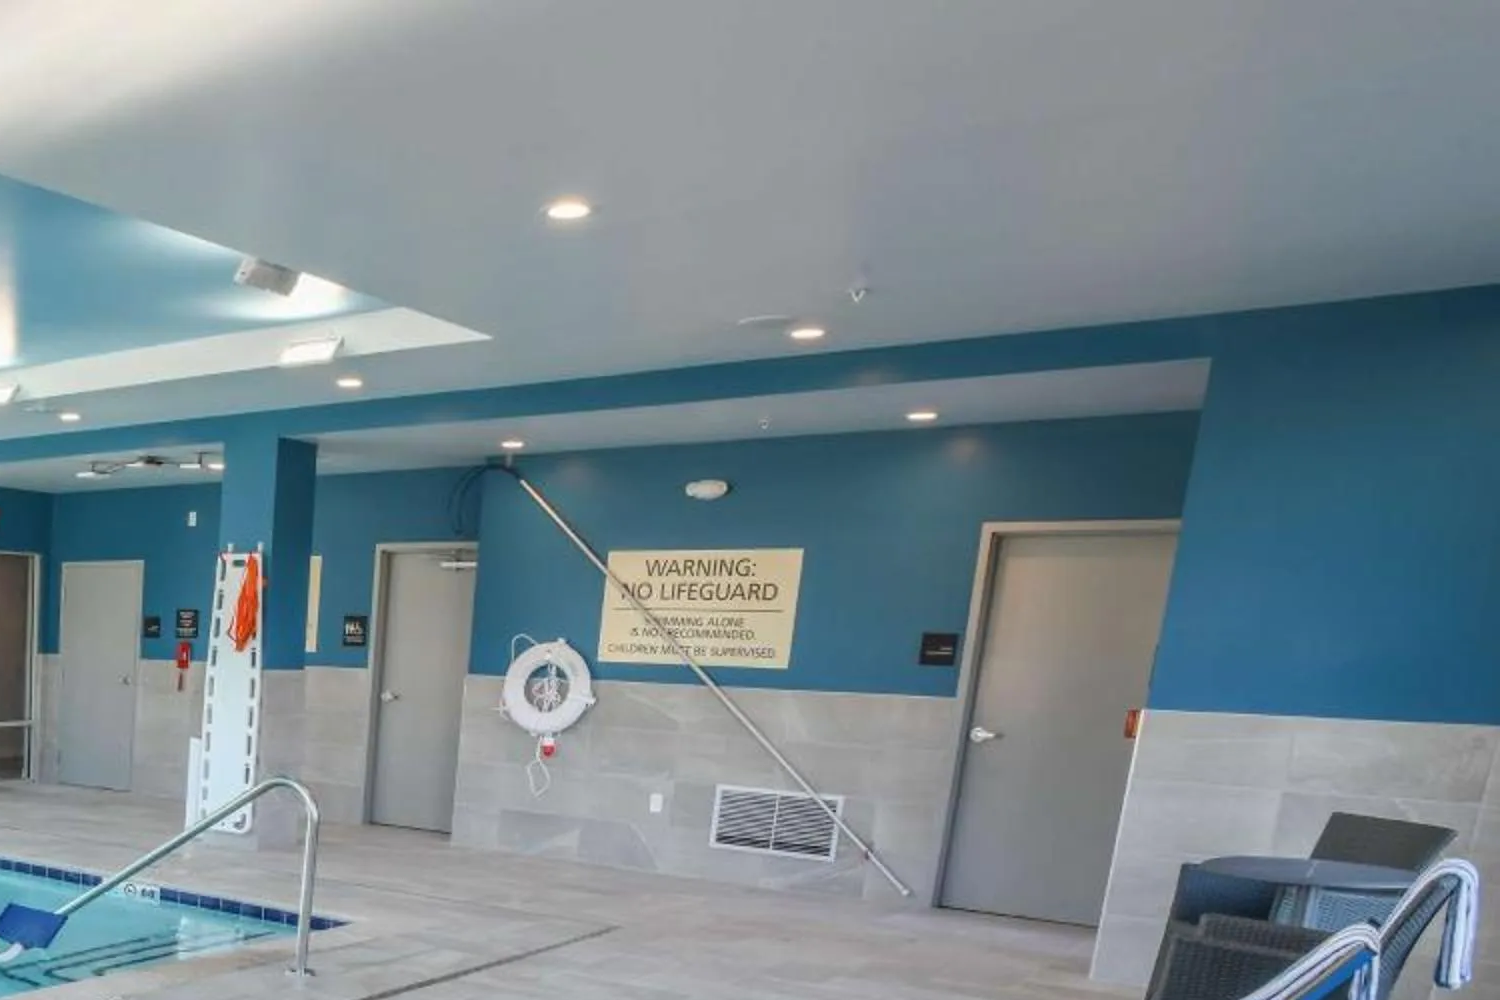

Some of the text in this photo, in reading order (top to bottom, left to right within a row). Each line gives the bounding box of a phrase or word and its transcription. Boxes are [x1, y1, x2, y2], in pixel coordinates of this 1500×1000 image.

[645, 558, 757, 577] WARNING:
[621, 582, 779, 601] NO LIFEGUARD
[641, 627, 664, 637] NO
[660, 643, 692, 657] MUT
